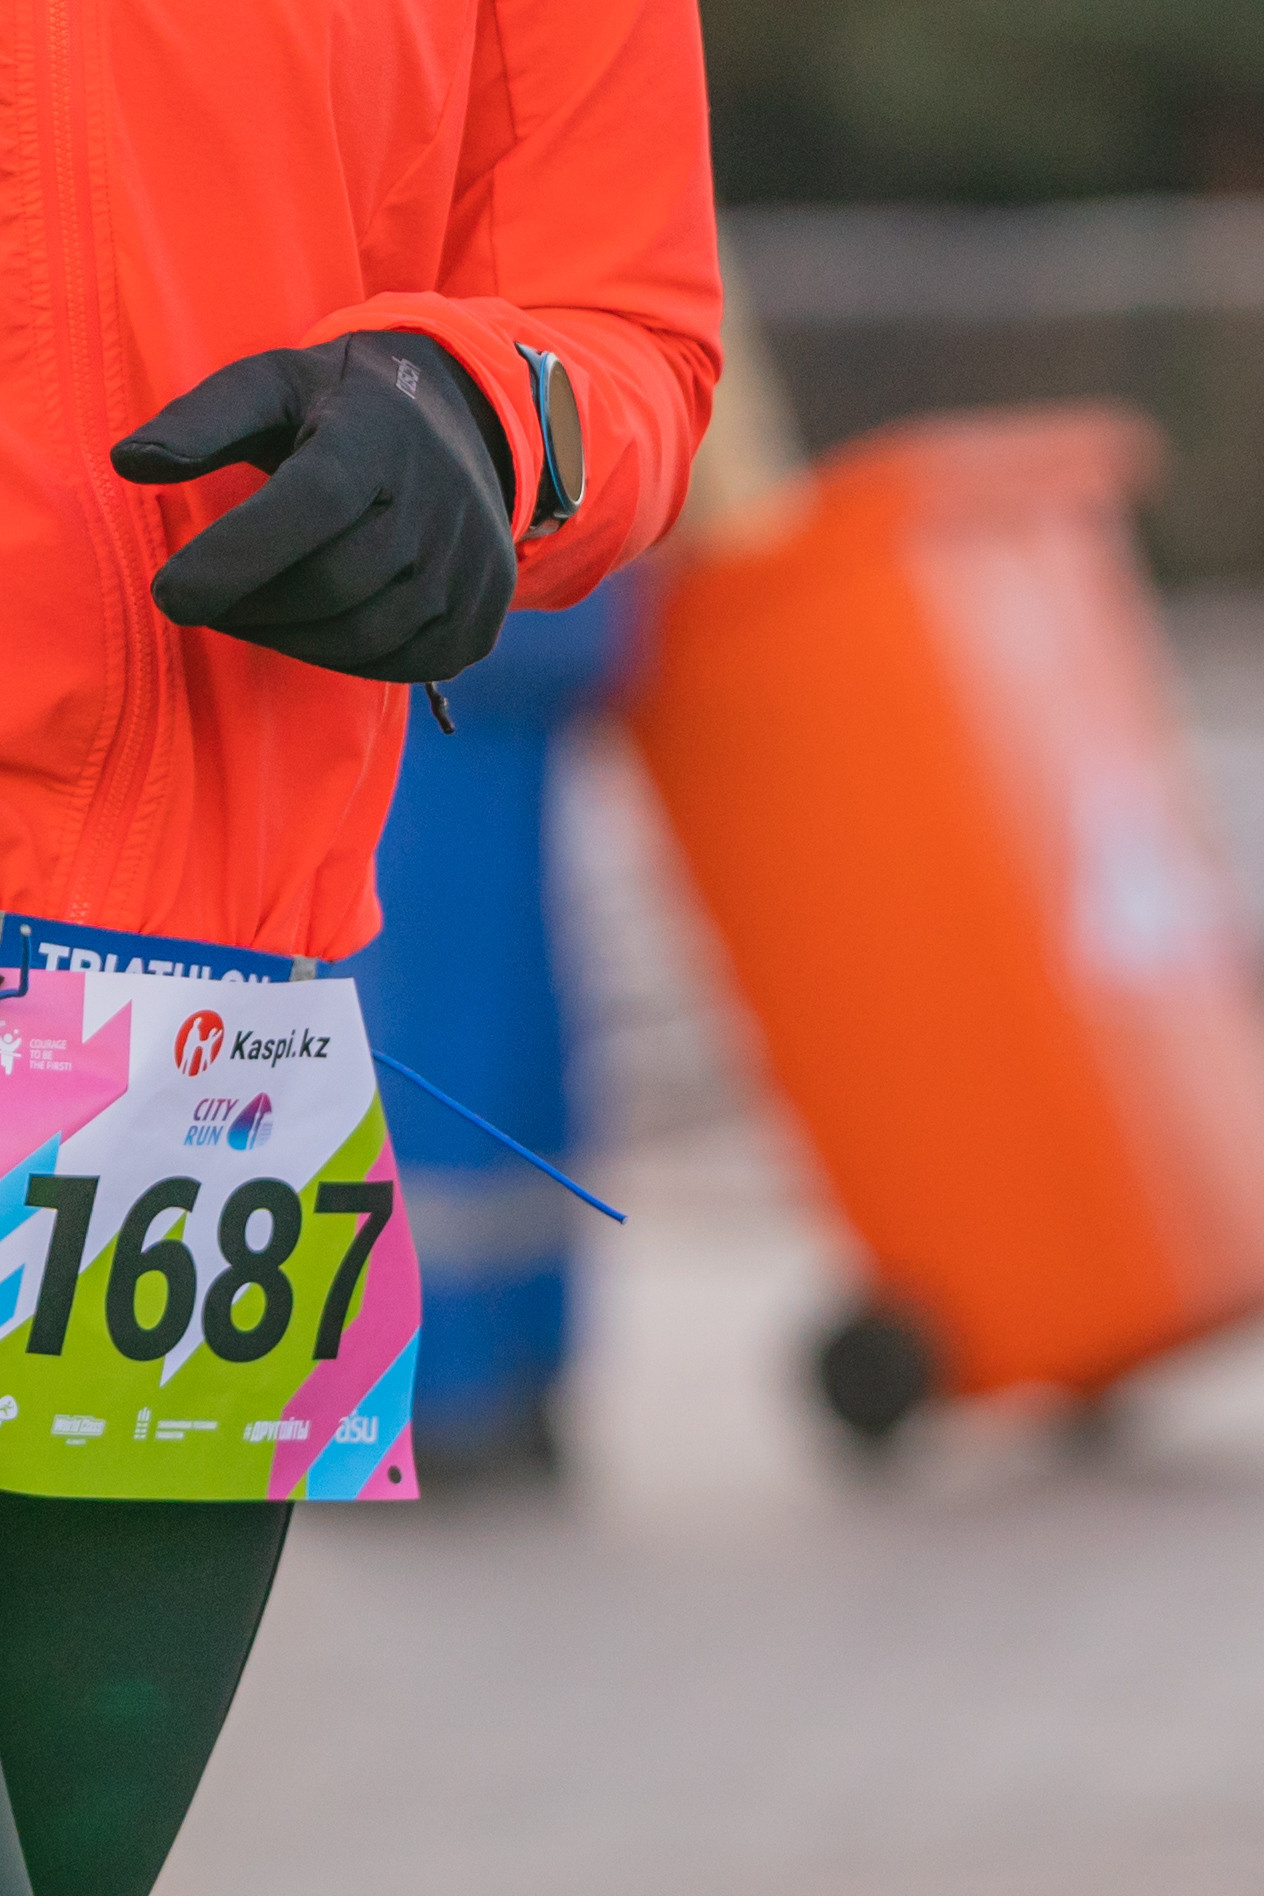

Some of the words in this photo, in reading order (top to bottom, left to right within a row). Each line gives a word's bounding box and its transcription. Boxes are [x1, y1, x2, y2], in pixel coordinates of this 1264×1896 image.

[29, 1038, 67, 1050] COURAGE
[30, 1049, 41, 1059] TO
[42, 1050, 53, 1060] BE
[229, 1027, 331, 1068] Kaspi.kz
[29, 1059, 45, 1070] THE
[193, 1098, 239, 1122] CITY
[183, 1125, 224, 1146] RUN
[24, 1173, 394, 1363] 1687
